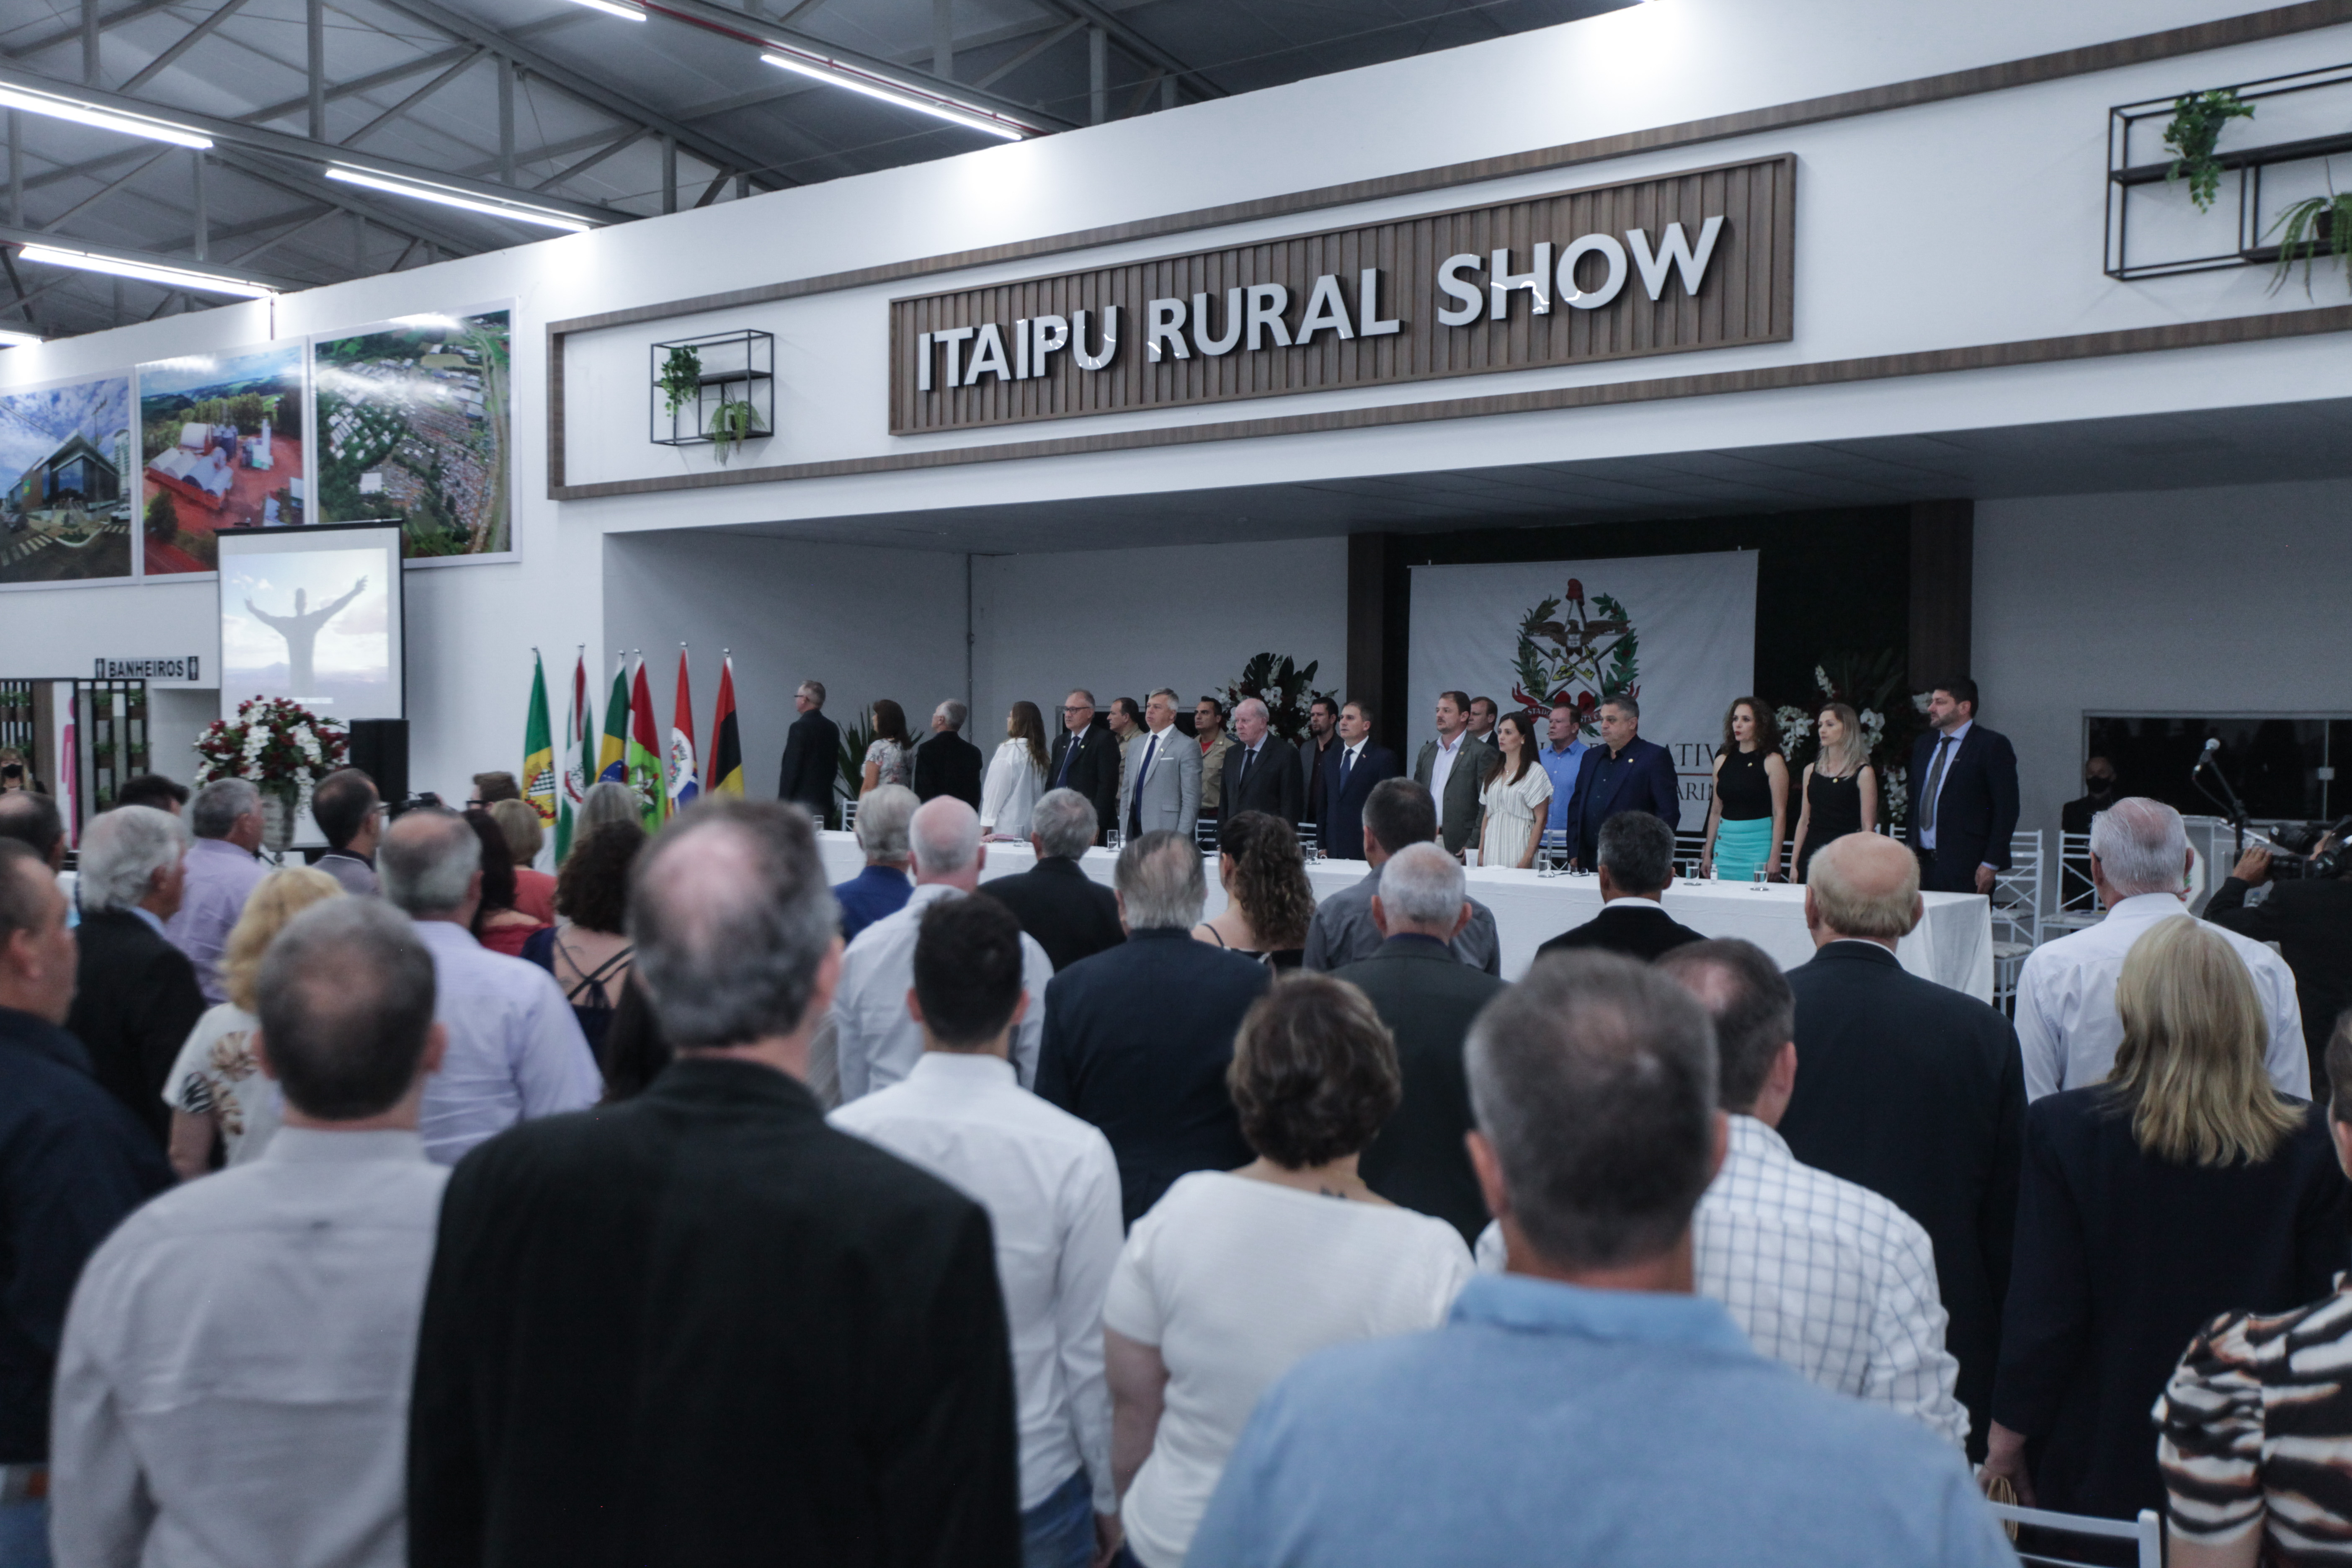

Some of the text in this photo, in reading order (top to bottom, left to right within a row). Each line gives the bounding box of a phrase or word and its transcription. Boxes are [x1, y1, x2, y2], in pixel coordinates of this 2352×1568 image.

[919, 215, 1725, 391] ITAIPU RURAL SHOW
[109, 660, 184, 678] BANHEIROS
